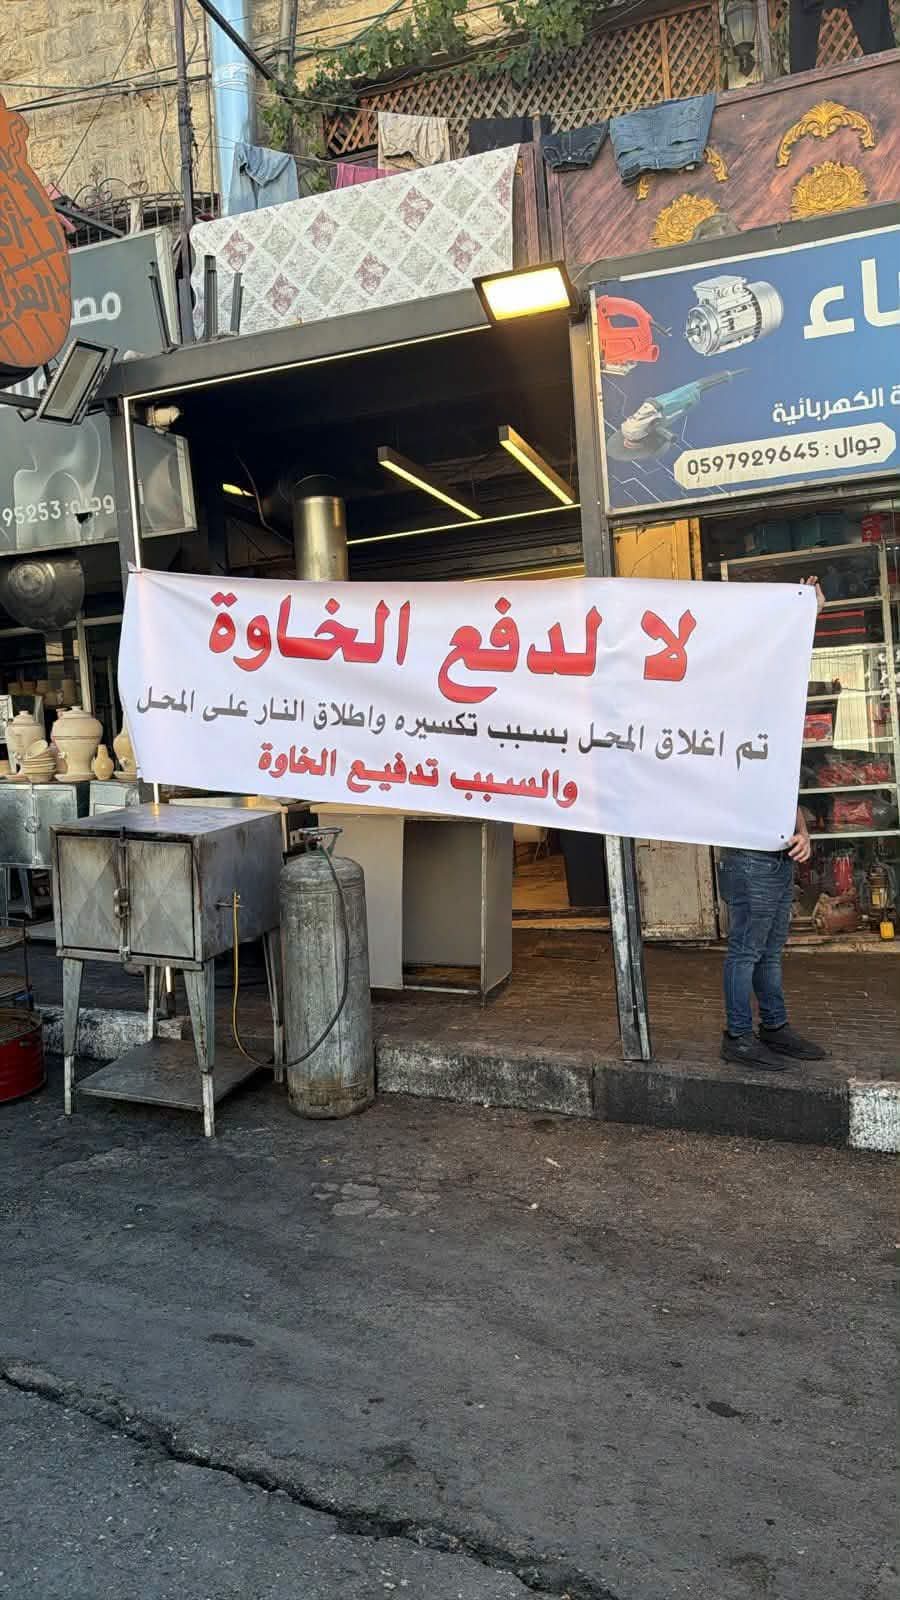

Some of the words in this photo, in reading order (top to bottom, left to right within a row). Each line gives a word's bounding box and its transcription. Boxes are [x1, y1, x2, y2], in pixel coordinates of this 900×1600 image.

[772, 387, 884, 425] الكهربائية
[687, 440, 820, 477] 0597929645
[209, 591, 411, 672] الخاوة
[640, 608, 697, 682] لا
[438, 596, 603, 704] لدفع
[136, 685, 195, 714] المحل
[202, 692, 249, 722] على
[254, 696, 305, 726] النار
[313, 701, 386, 735] واطلاق
[394, 711, 478, 740] تكسيره
[487, 721, 569, 754] بسبب
[578, 722, 645, 754] المحل
[654, 727, 725, 760] اغلاق
[735, 732, 769, 770] تم
[257, 742, 338, 778] الخاوة
[346, 751, 440, 794] تدفيع
[450, 767, 579, 809] والسبب
